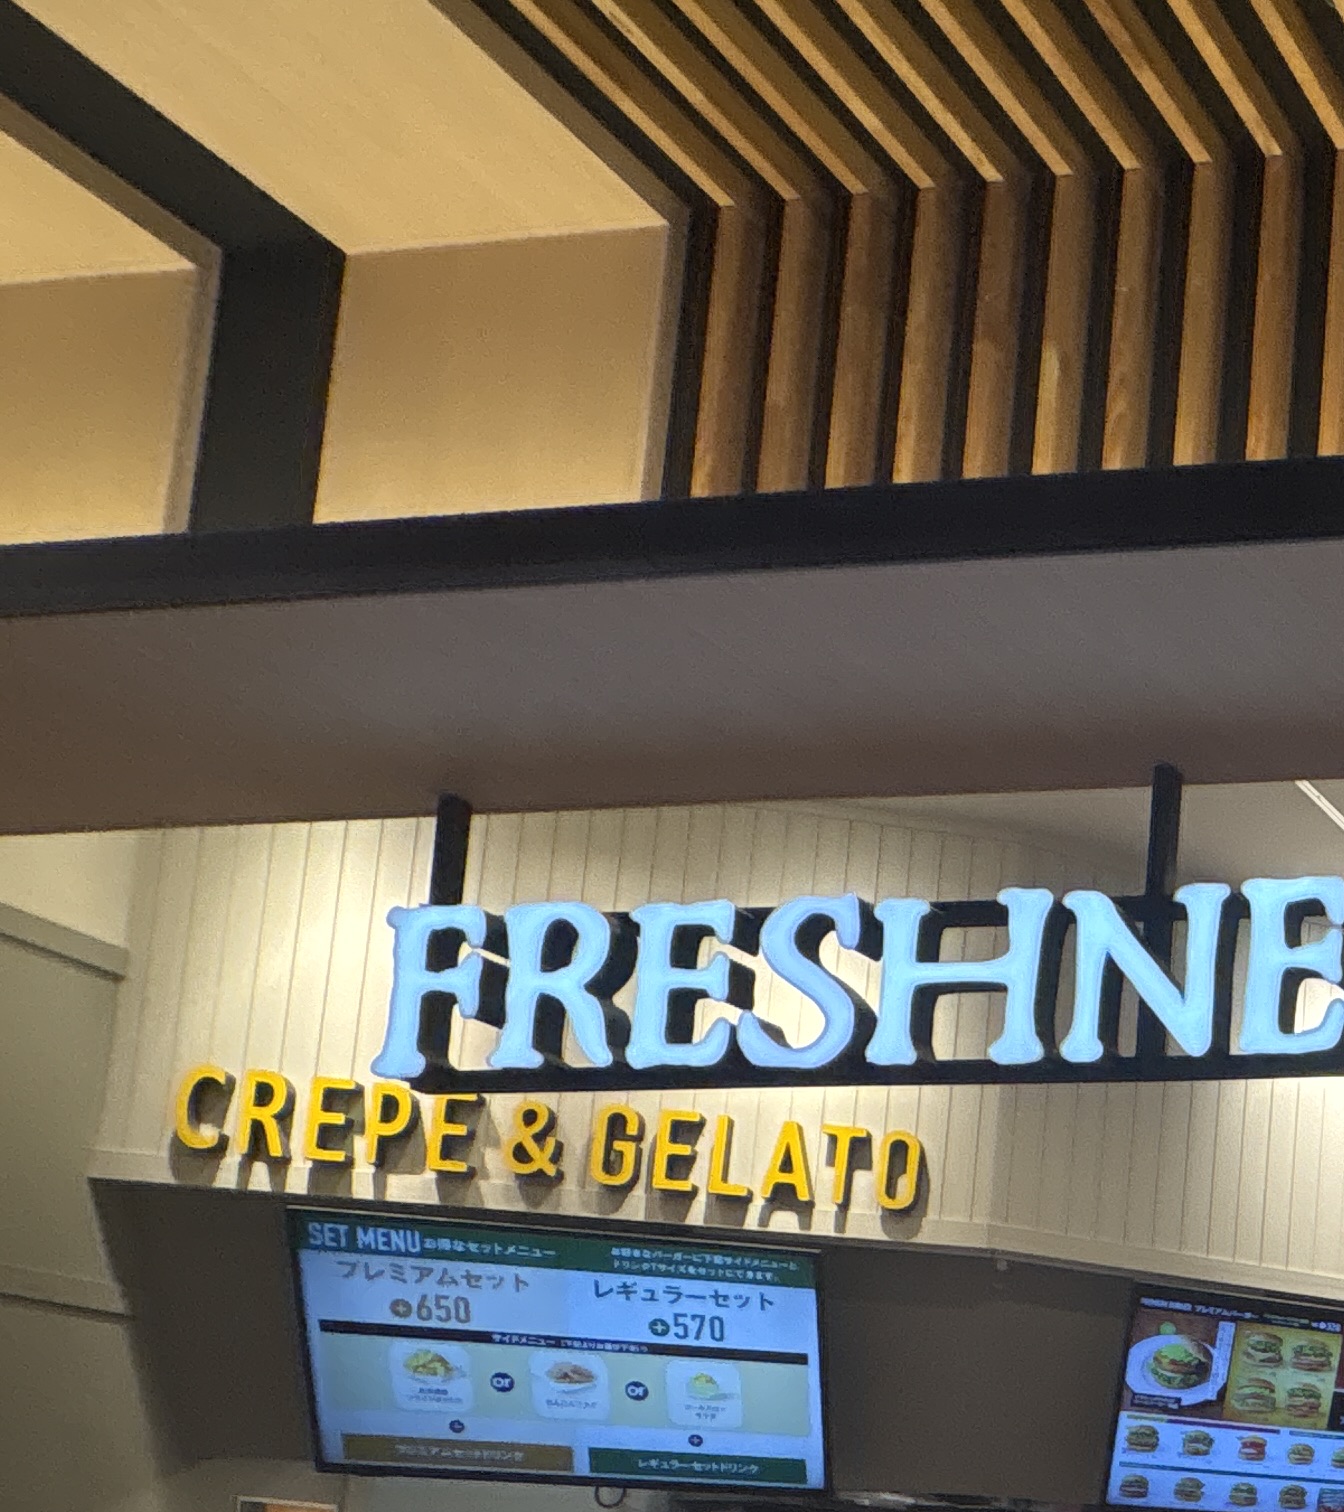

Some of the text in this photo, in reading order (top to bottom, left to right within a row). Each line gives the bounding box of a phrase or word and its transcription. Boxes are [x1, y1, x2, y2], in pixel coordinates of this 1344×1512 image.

[172, 1064, 922, 1212] CREPE & GELATO
[307, 1221, 349, 1247] SET
[355, 1225, 421, 1254] MENU
[336, 1260, 529, 1293] プレミアムセット
[593, 1278, 775, 1312] レギュラーセット
